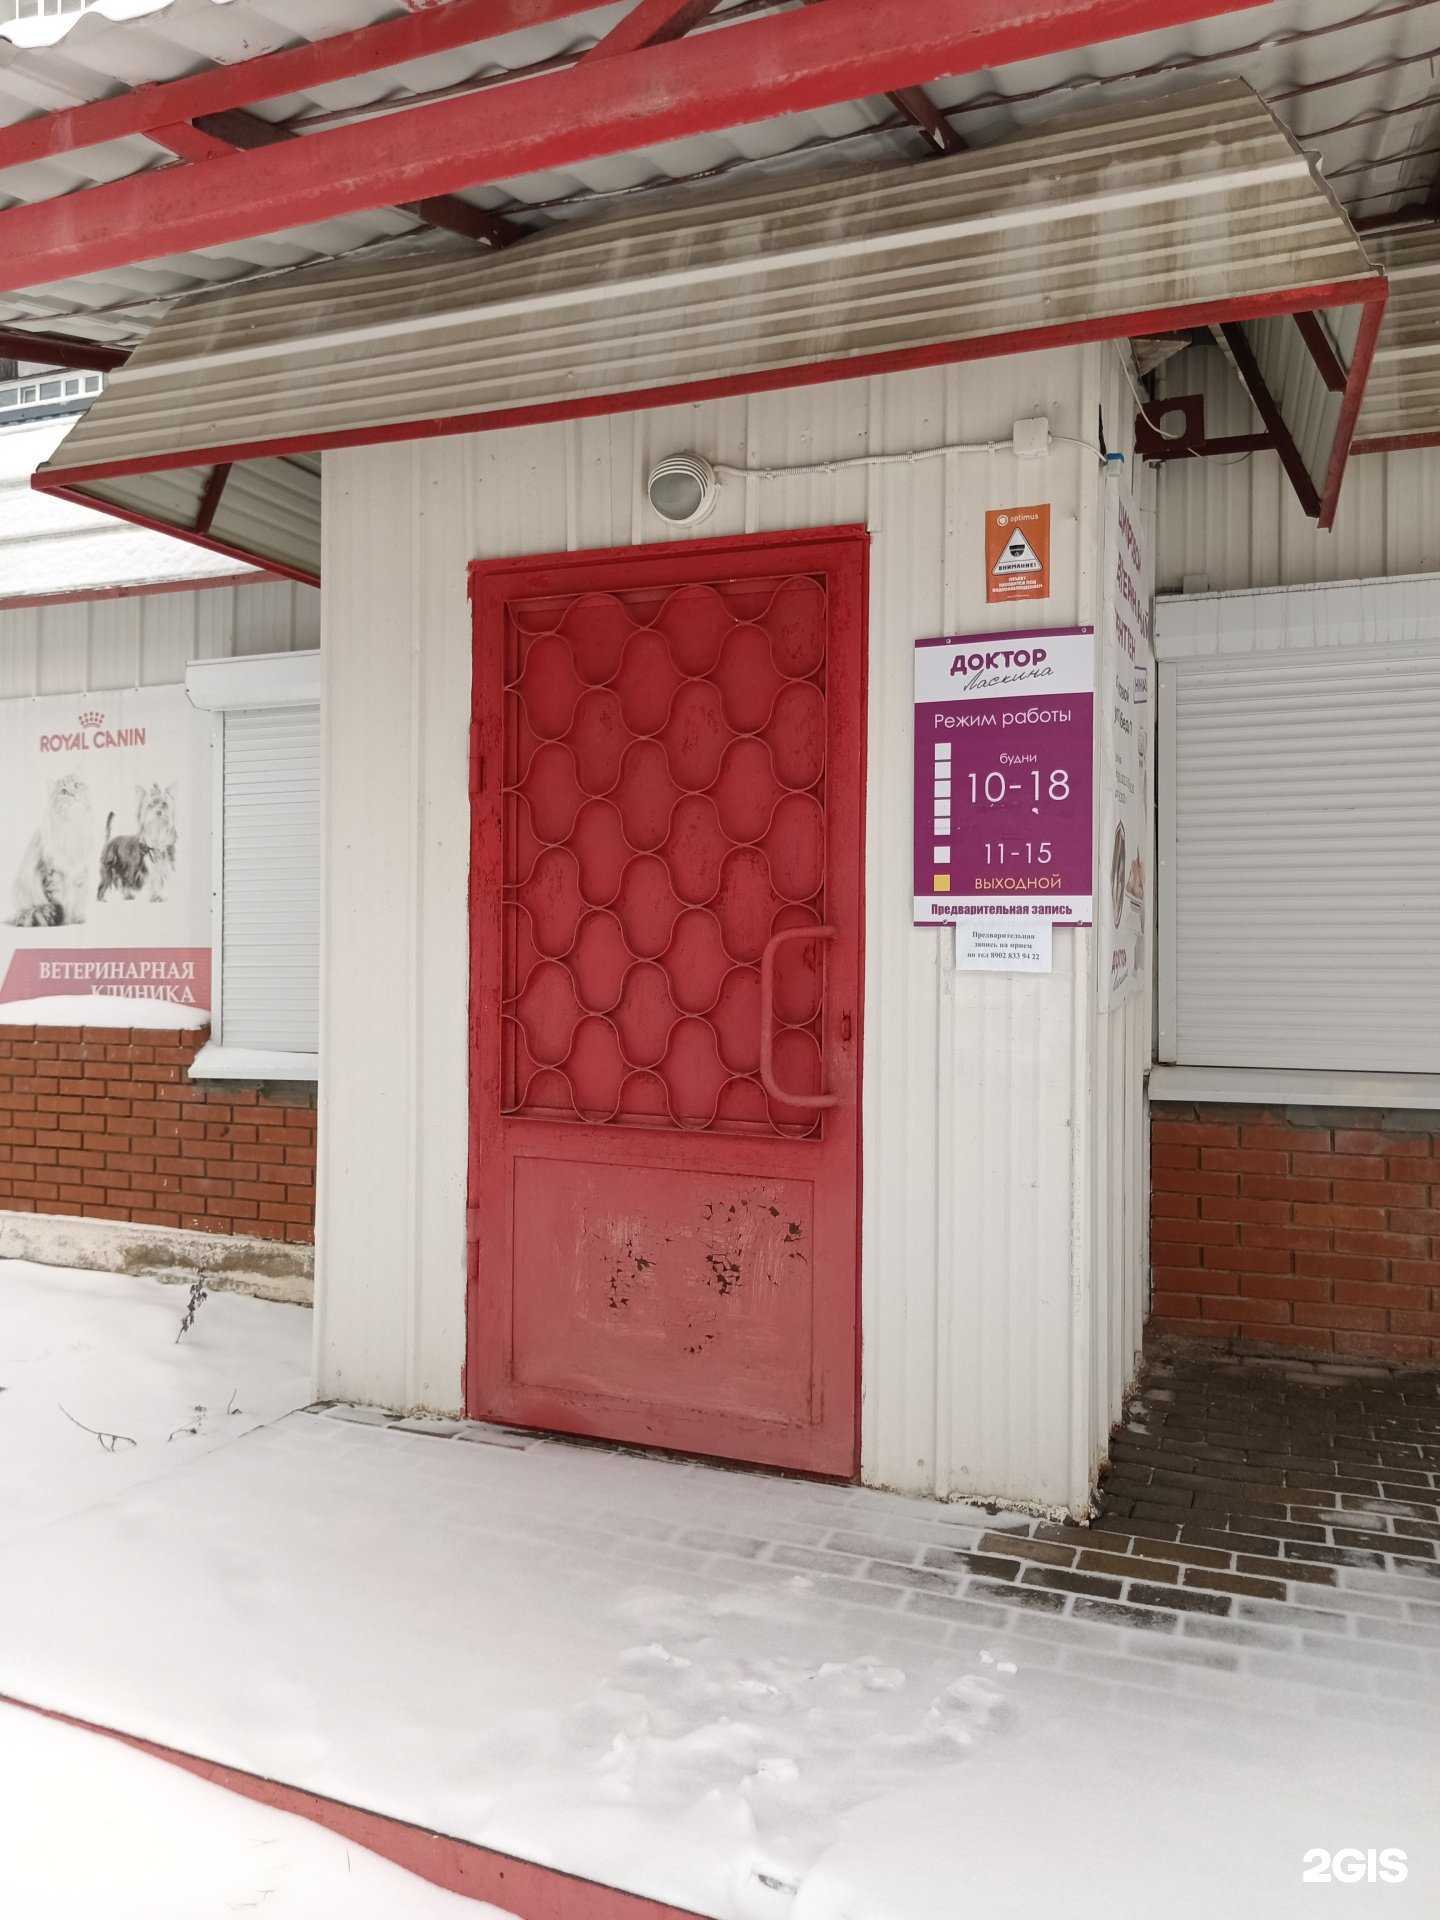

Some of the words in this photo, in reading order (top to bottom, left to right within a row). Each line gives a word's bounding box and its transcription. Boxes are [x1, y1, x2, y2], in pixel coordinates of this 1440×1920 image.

[1010, 513, 1039, 523] optimus
[950, 648, 1047, 676] ДОКТОР
[963, 666, 1054, 692] Ласкина
[934, 713, 997, 729] Режим
[1002, 707, 1071, 729] работы
[40, 731, 90, 752] ROYAL
[93, 727, 146, 749] CANIN
[999, 752, 1038, 768] будни
[967, 769, 1070, 803] 10-18
[984, 842, 1052, 865] 11-15
[931, 904, 1029, 917] Предварительная
[1031, 904, 1073, 915] запись
[39, 961, 196, 980] ВЕТЕРИНАРНАЯ
[91, 985, 196, 1003] КЛИНИКА
